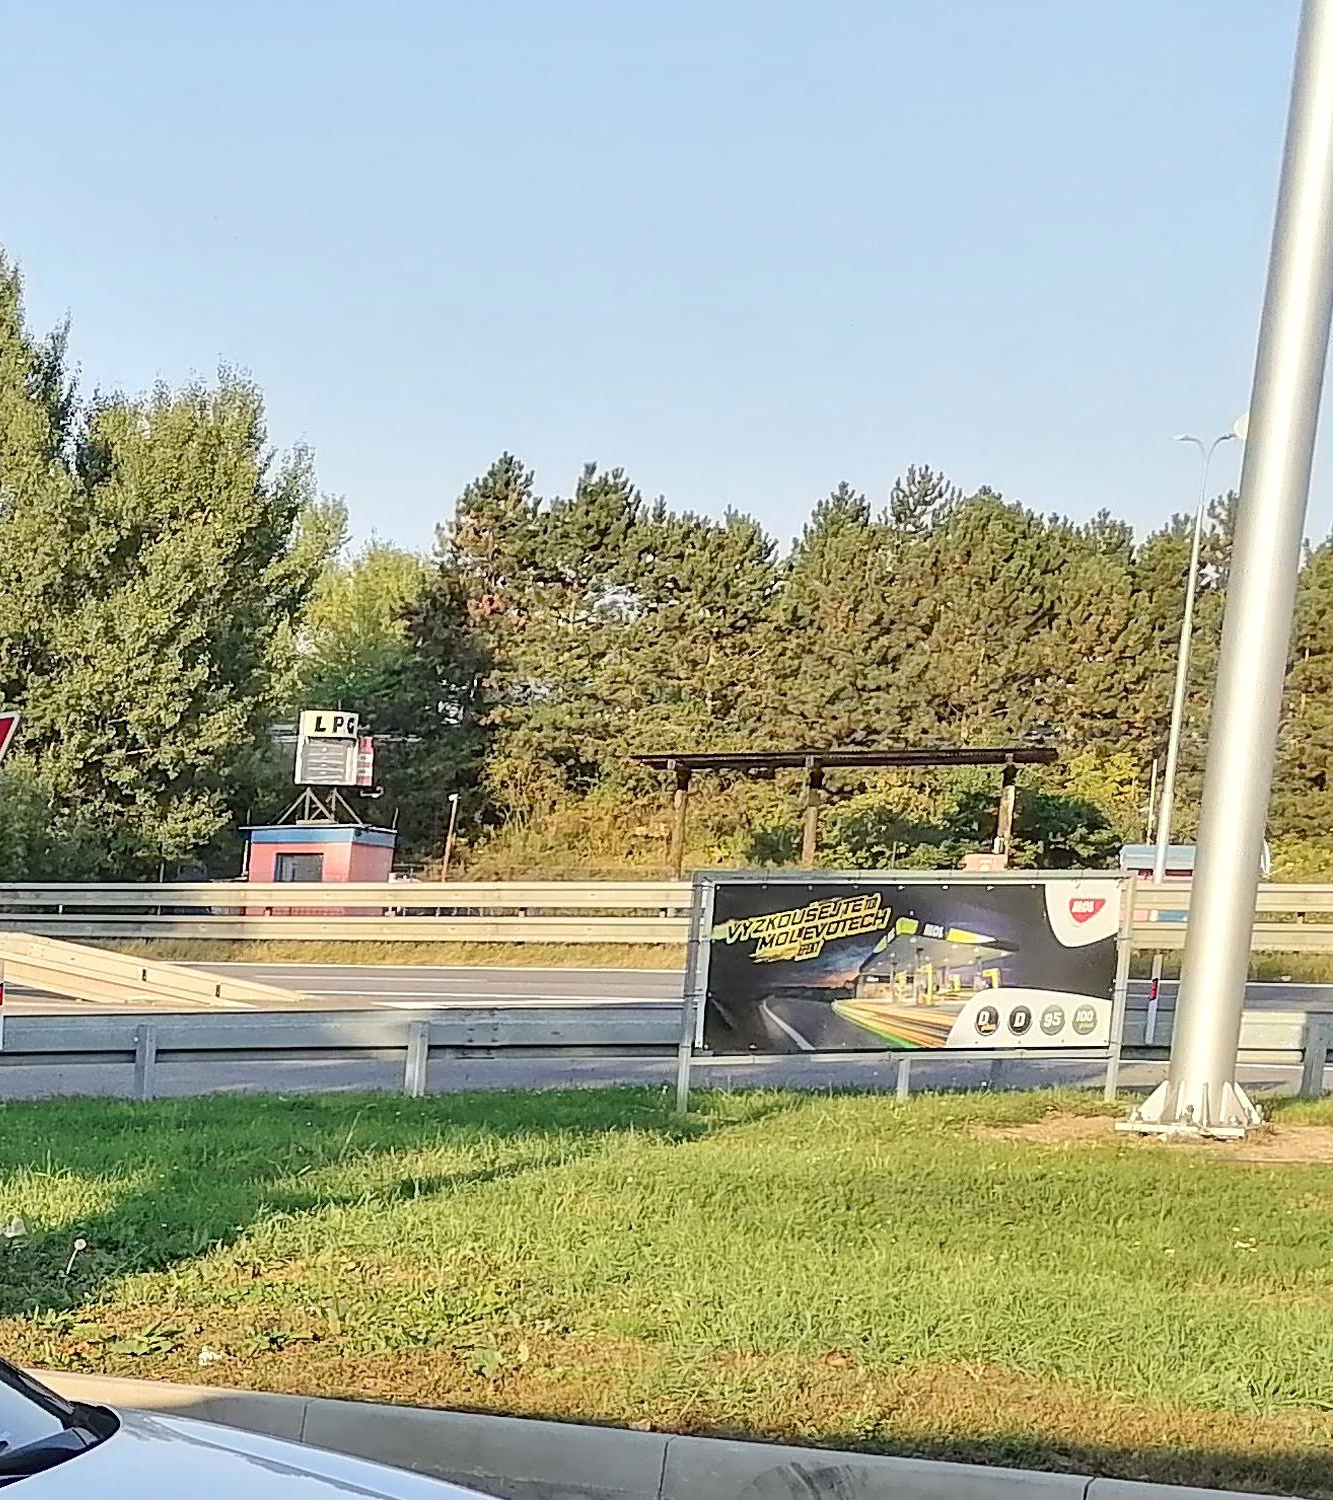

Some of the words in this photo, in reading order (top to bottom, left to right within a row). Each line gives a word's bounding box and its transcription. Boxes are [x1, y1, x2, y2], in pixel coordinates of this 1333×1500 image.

[728, 897, 865, 938] VYZKOUŠEJTE
[1013, 1010, 1027, 1028] D
[1043, 1011, 1063, 1029] 95
[1076, 1010, 1094, 1023] 100
